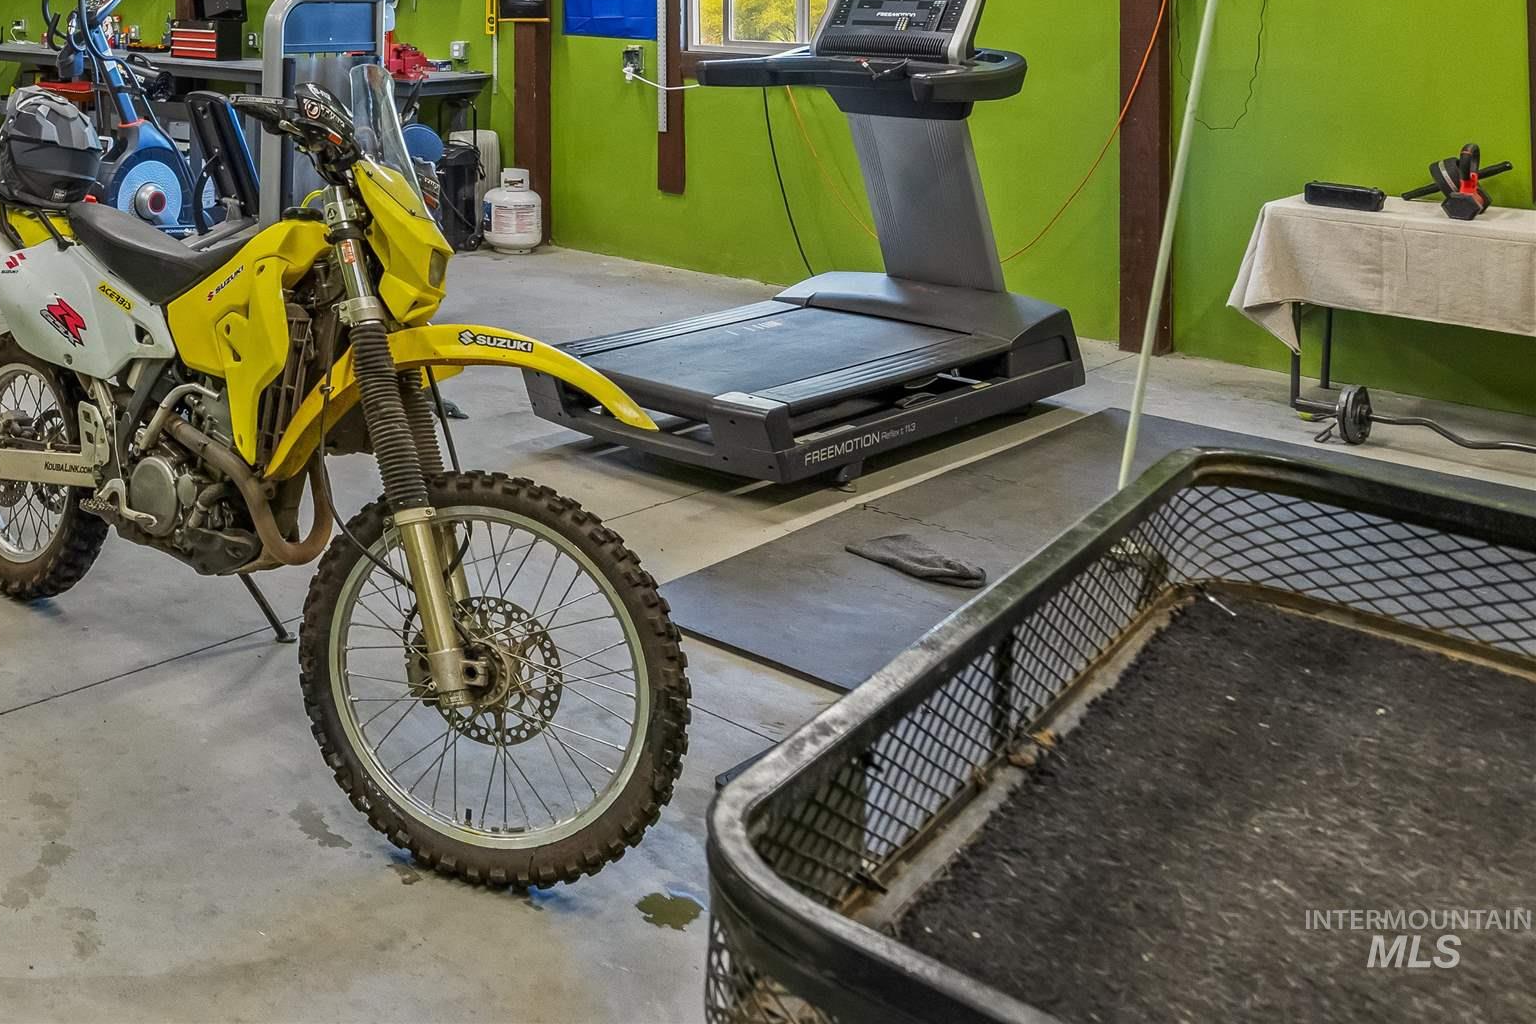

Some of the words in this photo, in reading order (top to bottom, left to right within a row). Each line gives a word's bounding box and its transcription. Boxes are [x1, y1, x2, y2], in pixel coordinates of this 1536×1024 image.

[215, 265, 244, 294] SUZUKI
[475, 334, 533, 352] SUZUKI
[804, 432, 880, 466] FREEMOTION
